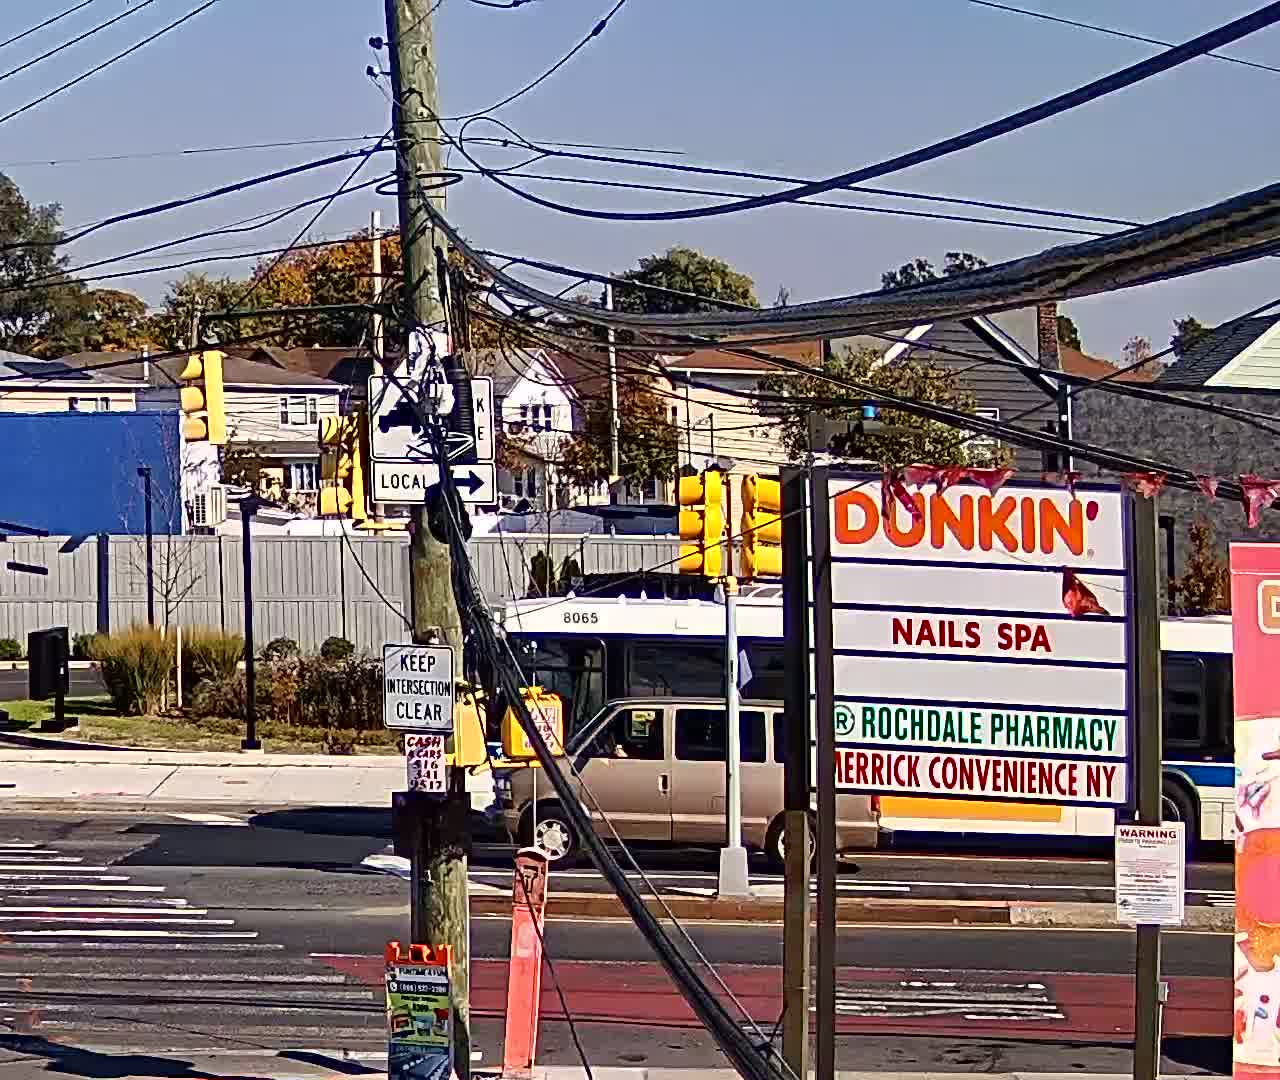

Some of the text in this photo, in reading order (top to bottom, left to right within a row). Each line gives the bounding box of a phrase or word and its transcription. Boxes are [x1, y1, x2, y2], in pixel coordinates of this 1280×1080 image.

[382, 474, 428, 489] LOCAL
[834, 490, 1099, 557] DUNKIN'
[563, 611, 598, 624] 8065
[892, 617, 1052, 652] NAILS SPA
[400, 655, 436, 673] KEEP
[387, 679, 451, 697] INTERSECTION
[396, 702, 442, 721] CLEAR
[862, 706, 983, 744] ROCHDALE
[991, 713, 1118, 752] PHARMACY
[406, 736, 441, 748] CASH
[416, 749, 442, 760] CARS
[929, 756, 1078, 796] CONVENIENCE
[1086, 764, 1118, 798] NY
[1119, 828, 1178, 840] WARNING
